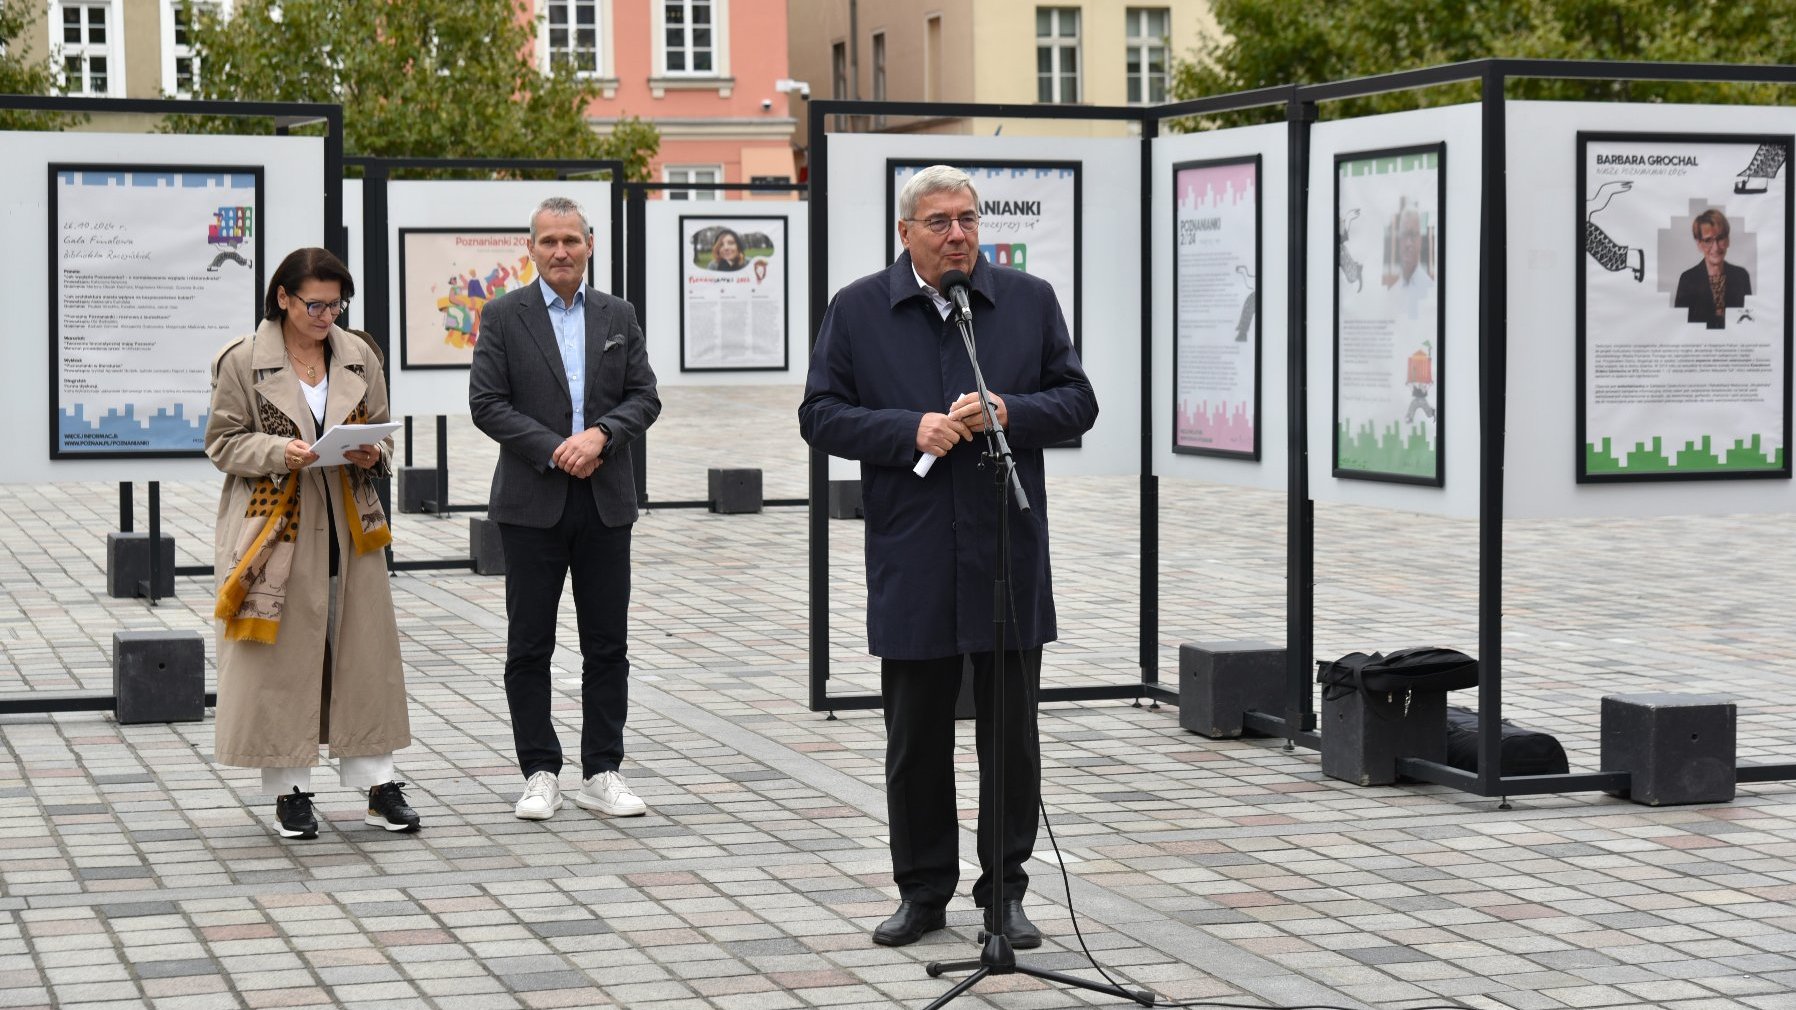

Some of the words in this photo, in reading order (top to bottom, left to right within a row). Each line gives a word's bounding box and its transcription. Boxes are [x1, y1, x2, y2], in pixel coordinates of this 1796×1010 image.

[1596, 154, 1646, 166] BARBARA
[1647, 155, 1699, 167] GROCHAL
[1180, 217, 1221, 232] POZNANIANKI
[63, 235, 85, 245] Gala
[455, 236, 512, 247] Poznanianki
[513, 236, 527, 247] 20
